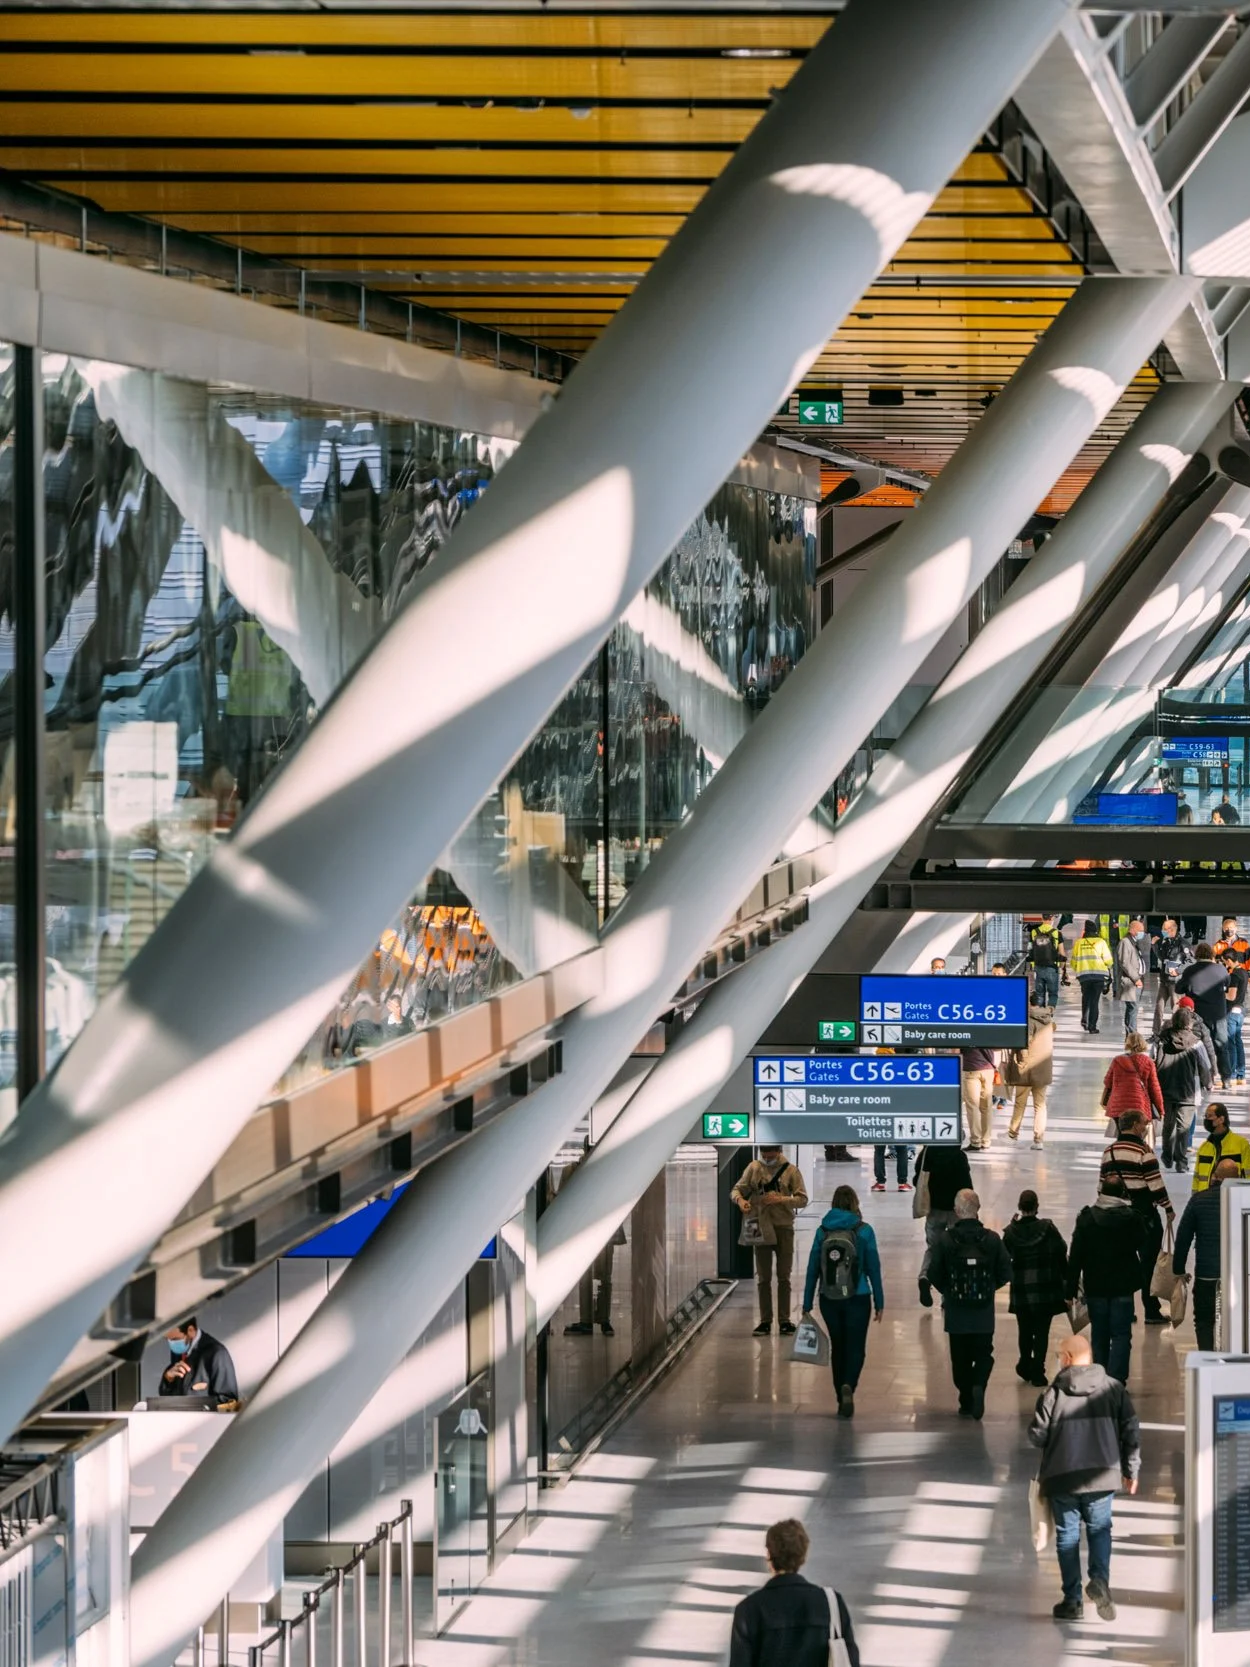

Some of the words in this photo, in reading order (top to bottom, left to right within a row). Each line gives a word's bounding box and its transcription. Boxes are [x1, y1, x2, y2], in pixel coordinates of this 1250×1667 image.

[904, 1001, 932, 1010] Portes
[937, 1003, 1007, 1021] C56-63
[904, 1011, 930, 1020] Gates
[904, 1029, 926, 1041] Baby
[927, 1031, 946, 1039] care
[948, 1031, 971, 1040] room
[809, 1059, 843, 1070] Portes
[849, 1061, 935, 1082] C56-63
[809, 1071, 840, 1082] Gates
[809, 1094, 836, 1107] Baby
[837, 1096, 860, 1105] care
[863, 1096, 891, 1105] room
[846, 1115, 892, 1126] Toilettes
[857, 1128, 892, 1139] Toilets
